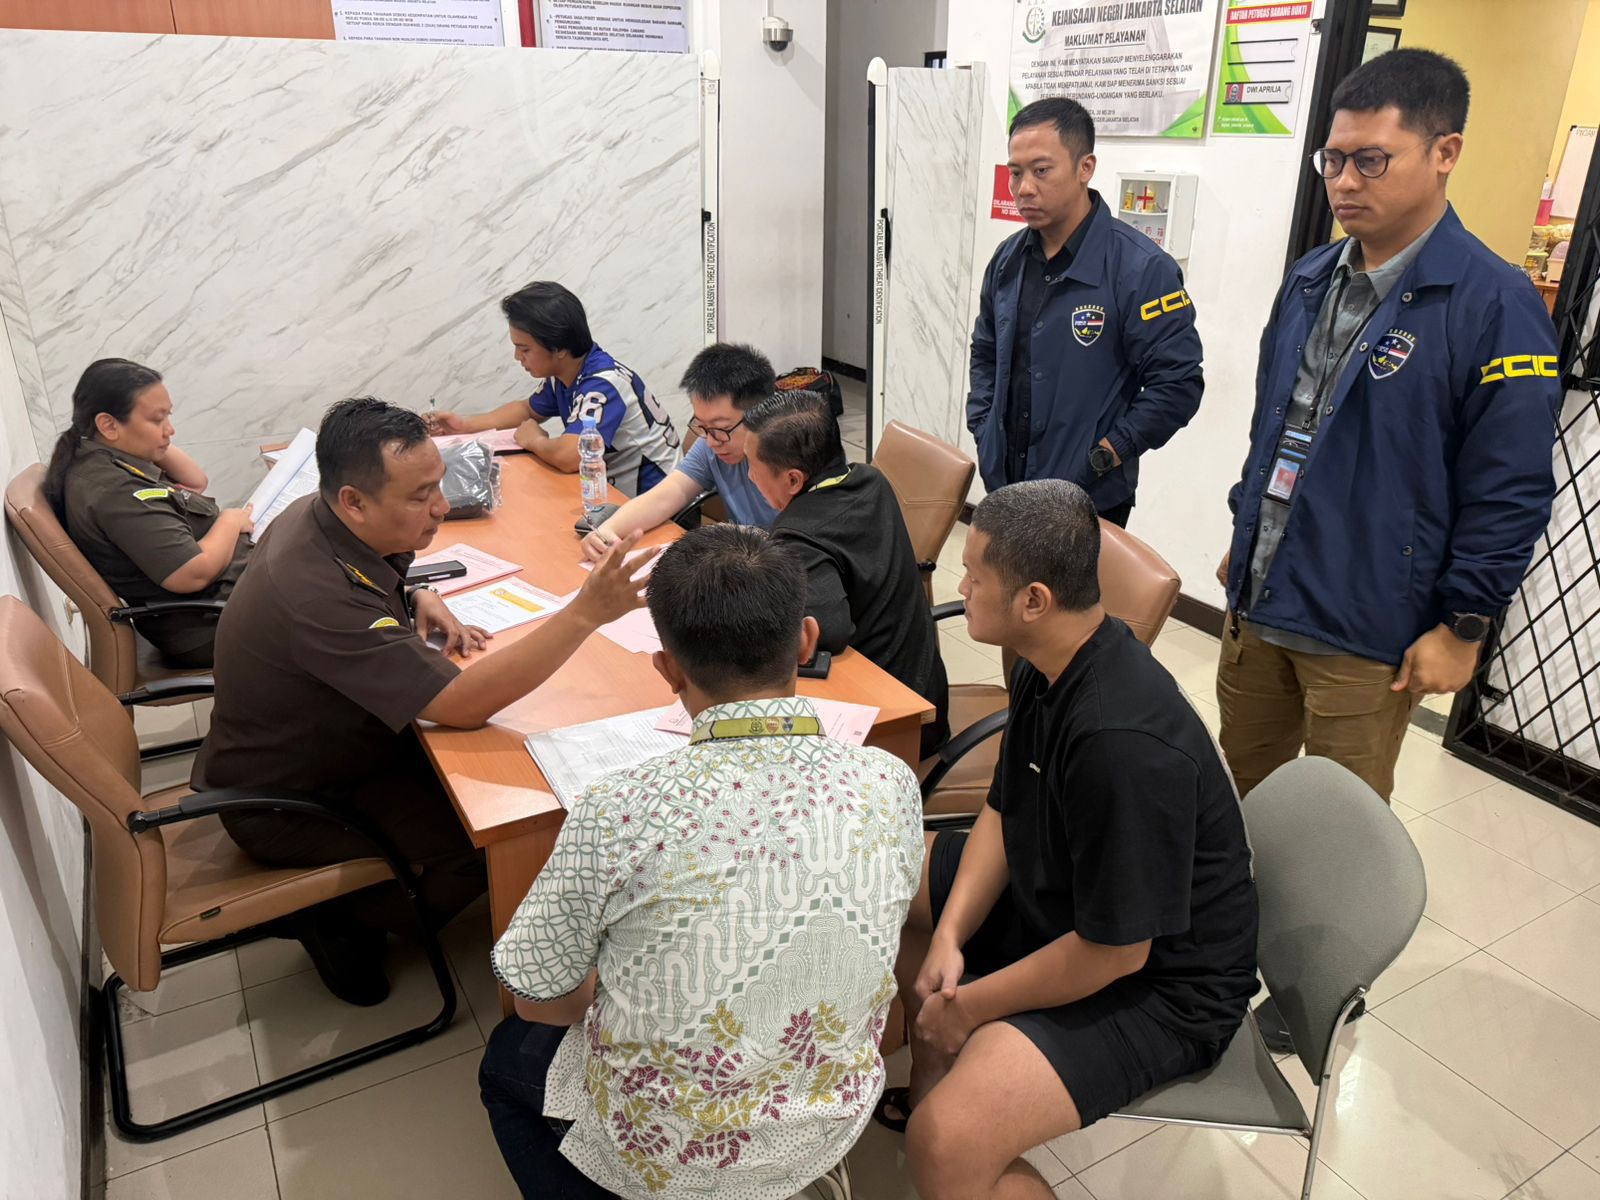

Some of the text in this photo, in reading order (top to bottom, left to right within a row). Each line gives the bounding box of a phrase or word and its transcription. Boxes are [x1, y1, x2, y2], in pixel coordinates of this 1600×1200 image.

[1052, 7, 1096, 26] KEJAKSAAN
[1124, 0, 1162, 19] JAKARTA
[1164, 0, 1203, 16] SELATAN
[1064, 29, 1146, 47] MAKLUMAT PELAYANAN
[1069, 57, 1101, 65] MENYATAKAN
[1152, 65, 1179, 73] TETAPKAN
[1180, 64, 1193, 72] DAN
[1124, 91, 1137, 99] YANG
[876, 219, 884, 245] PORTABLE
[876, 246, 884, 267] MASSIVE
[707, 222, 715, 334] PORTABLE MASSIVE THREAT IDENTIFICATION
